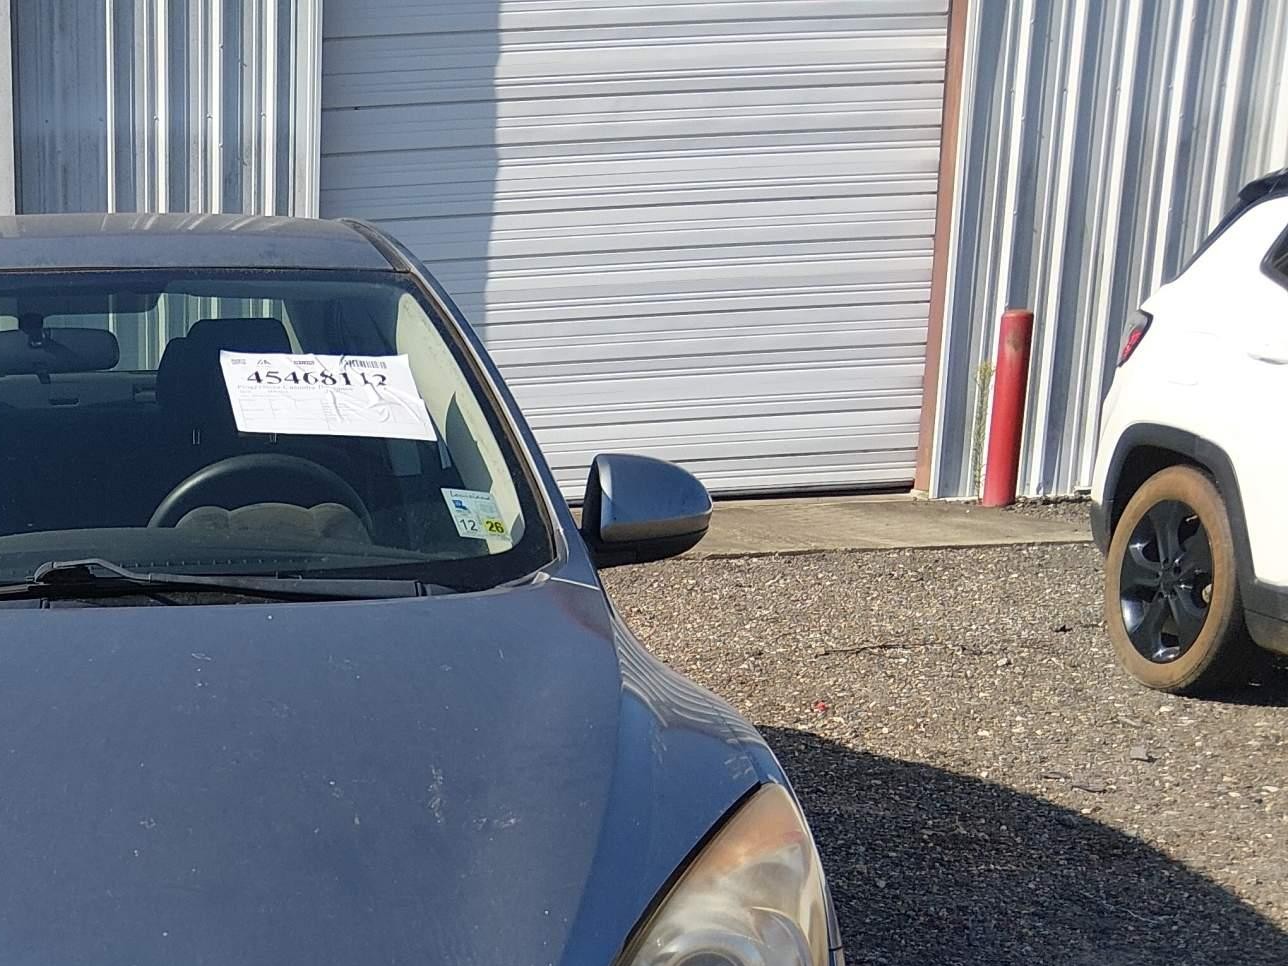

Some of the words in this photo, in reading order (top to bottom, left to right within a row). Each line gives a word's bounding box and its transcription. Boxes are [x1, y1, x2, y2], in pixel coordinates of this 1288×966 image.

[246, 370, 388, 386] 45468112
[459, 519, 479, 532] 12
[485, 520, 505, 534] 26
